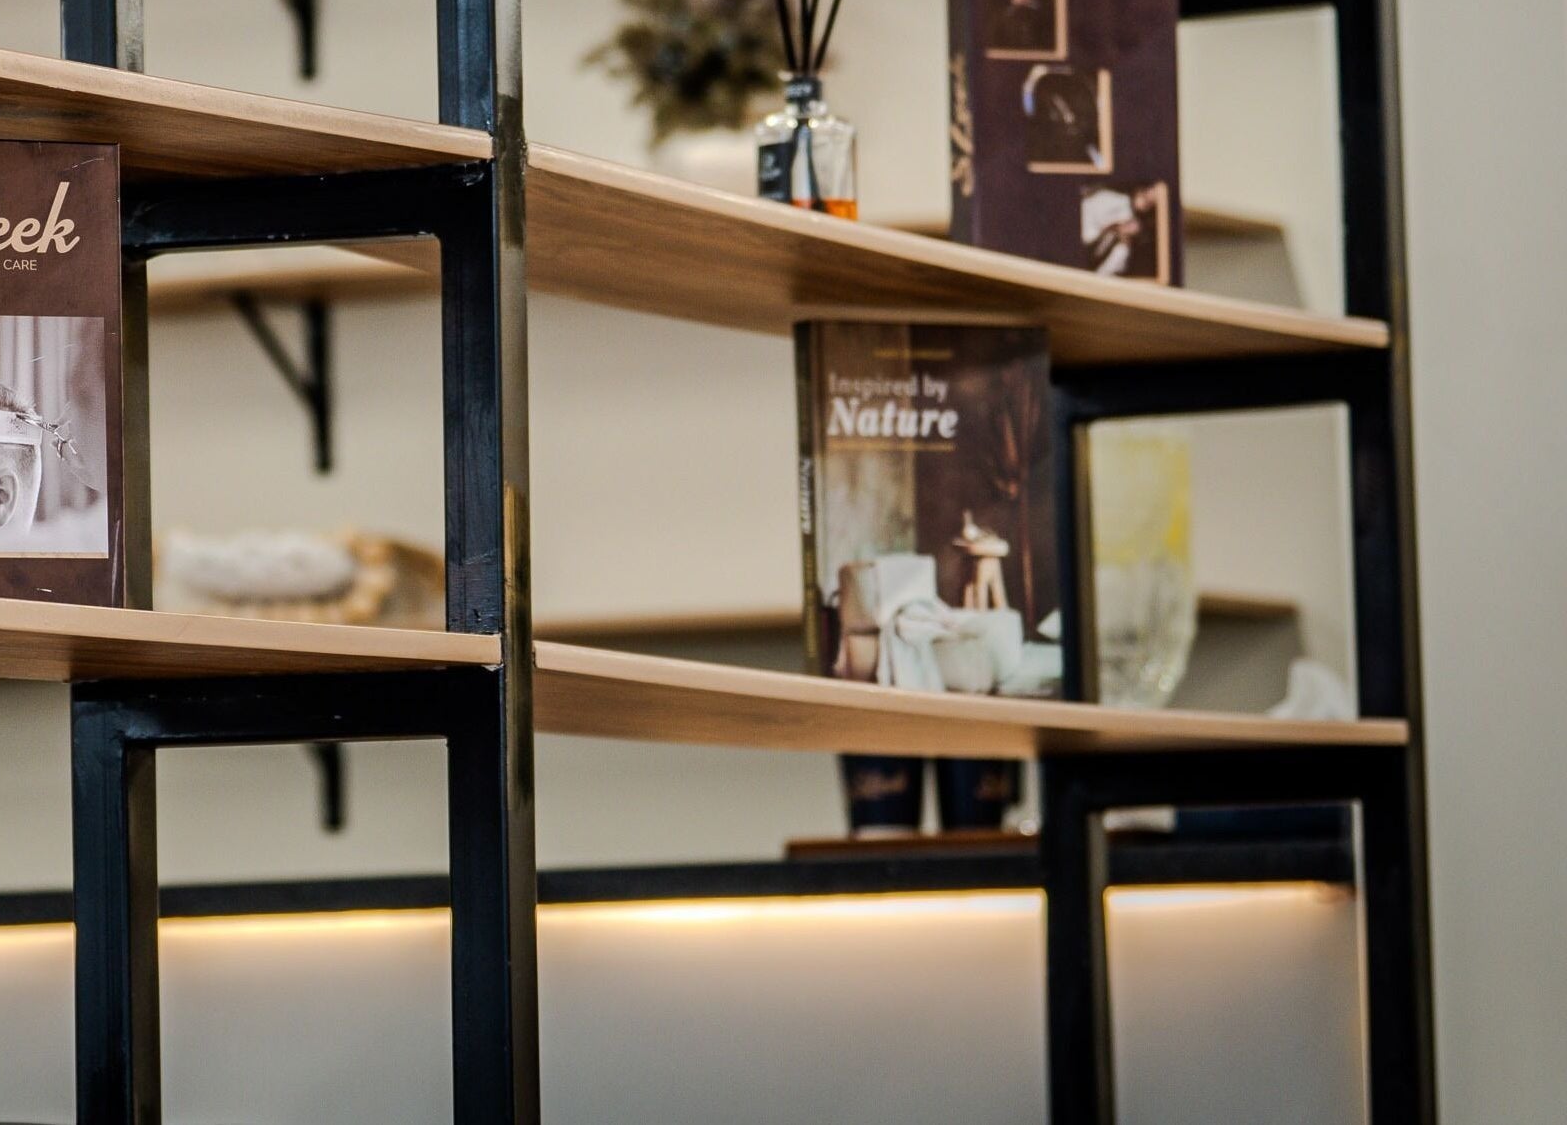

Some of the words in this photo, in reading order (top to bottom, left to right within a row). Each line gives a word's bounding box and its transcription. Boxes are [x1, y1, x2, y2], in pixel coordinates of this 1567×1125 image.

[3, 258, 38, 272] CARE
[922, 372, 949, 403] by
[826, 395, 960, 439] Nature
